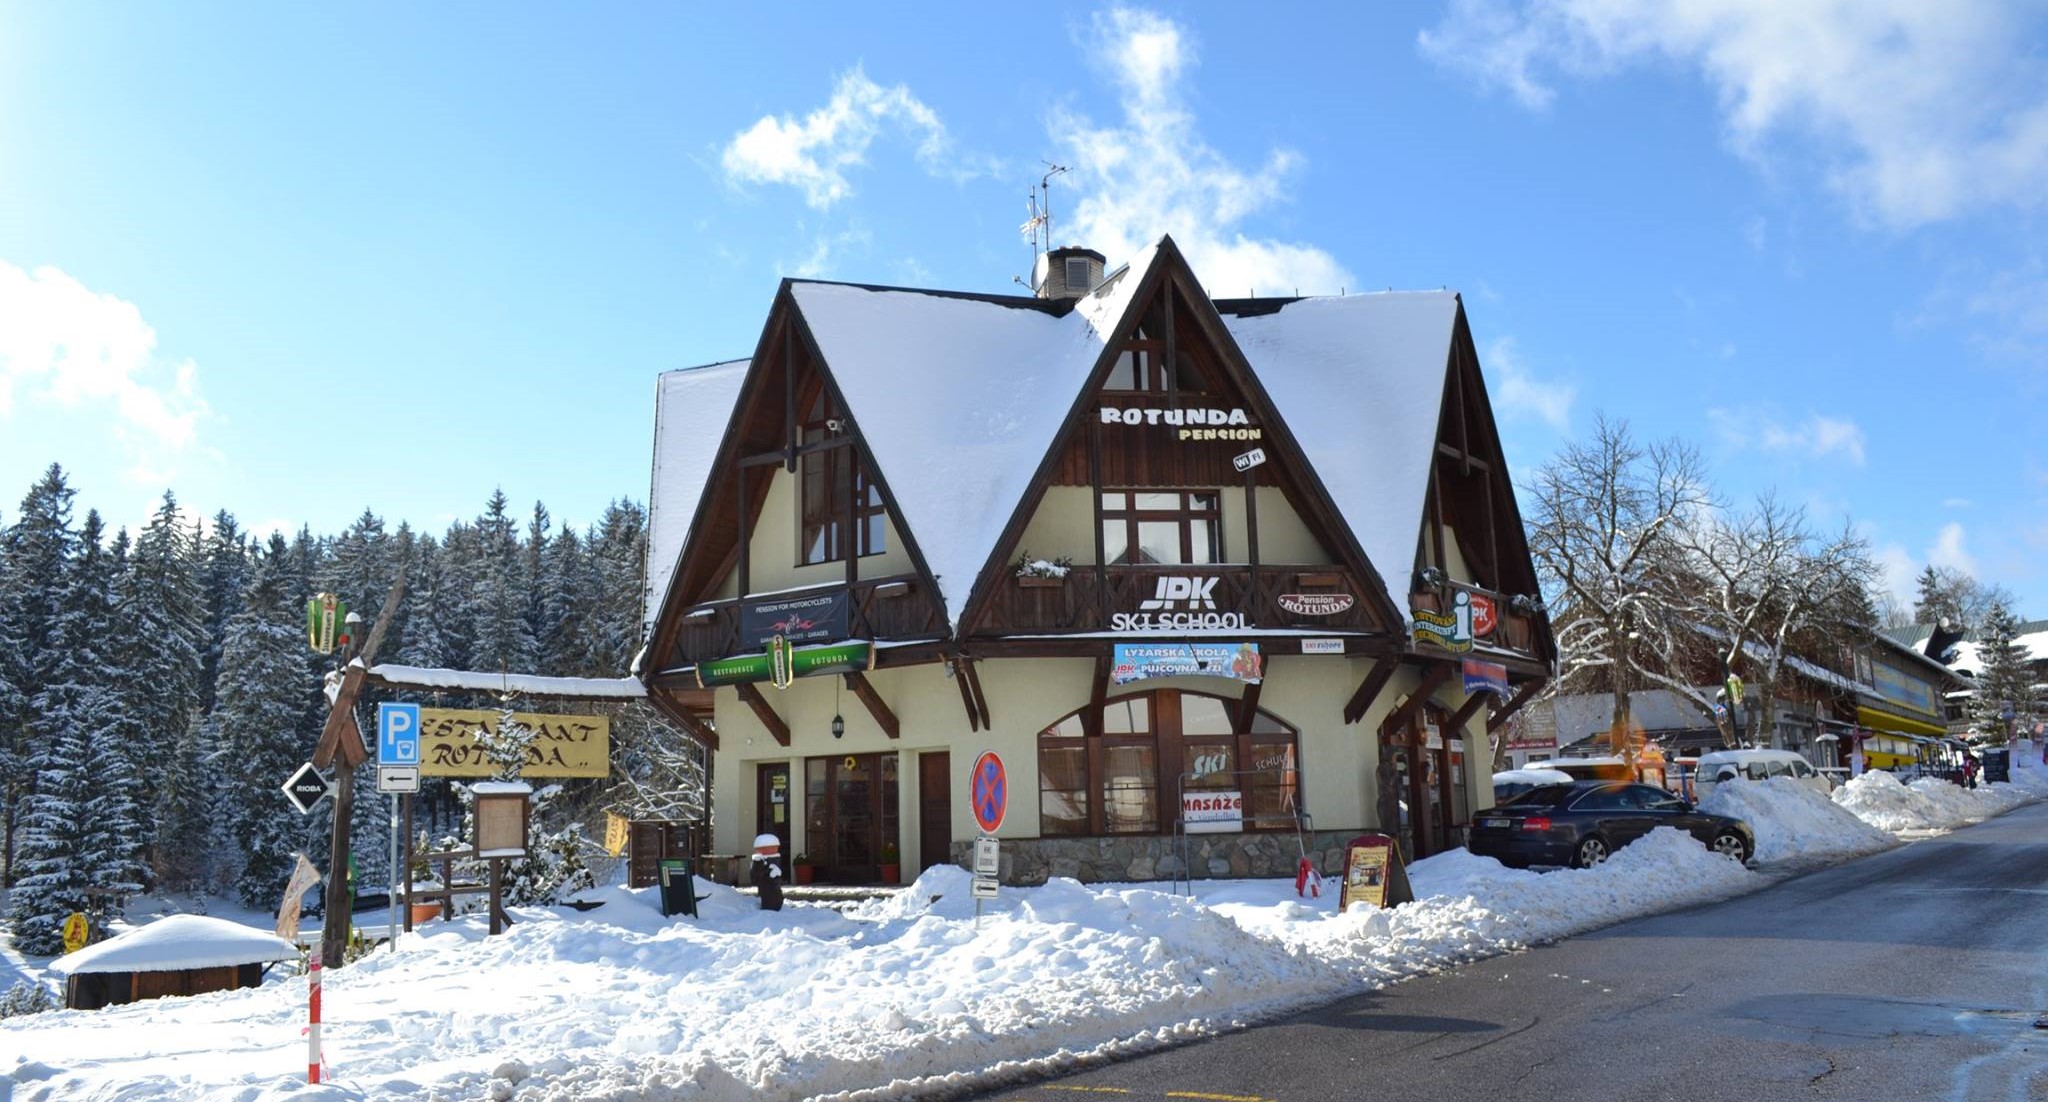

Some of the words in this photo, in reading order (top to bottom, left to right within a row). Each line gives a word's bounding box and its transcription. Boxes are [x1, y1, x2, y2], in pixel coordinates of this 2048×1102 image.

[1100, 407, 1248, 426] ROTUNDA
[1179, 428, 1261, 440] PENSION
[1235, 455, 1250, 468] WI
[1252, 452, 1261, 461] FI
[1140, 576, 1220, 610] JPK
[1298, 595, 1334, 604] Pension
[755, 604, 778, 613] PENSION
[778, 603, 789, 611] FOR
[789, 597, 833, 609] MOTORCYCLISTS
[1284, 599, 1349, 613] ROTUNDA
[1110, 613, 1151, 631] SKI
[1158, 612, 1253, 631] SCHOOL
[811, 654, 848, 665] ROTUNDA
[713, 664, 754, 677] RESTAURACE
[387, 710, 411, 745] P
[1191, 754, 1227, 780] SKI
